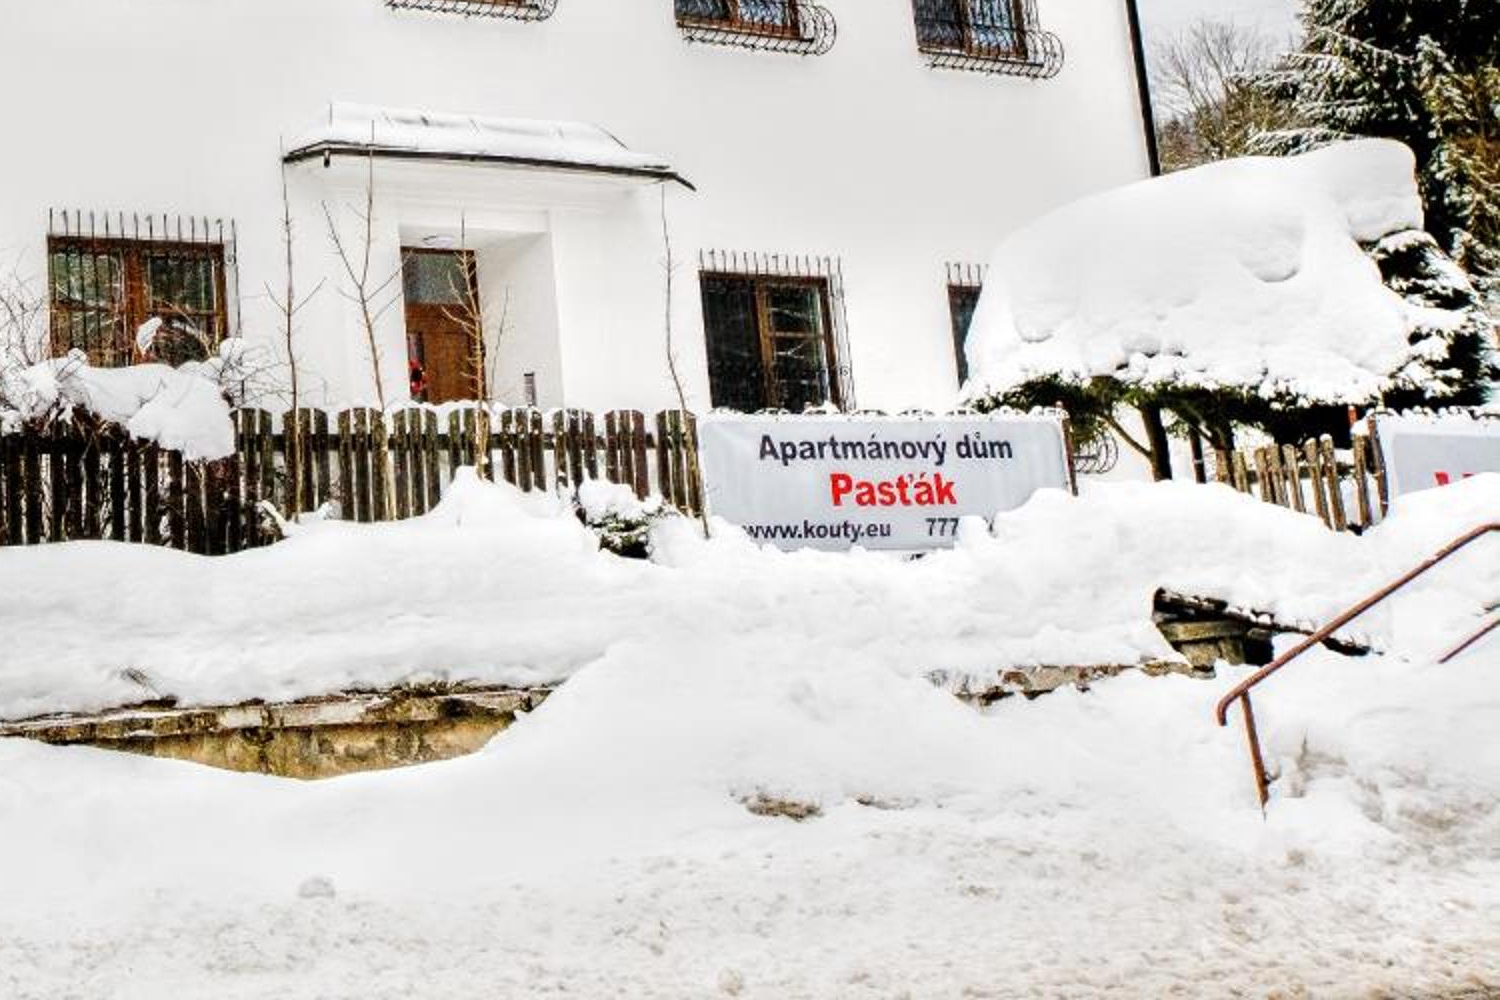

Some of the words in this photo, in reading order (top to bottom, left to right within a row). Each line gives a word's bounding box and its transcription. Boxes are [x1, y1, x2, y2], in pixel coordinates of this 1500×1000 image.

[758, 433, 947, 466] Apartmánový
[955, 431, 1014, 460] dům
[829, 471, 958, 507] Pasťák
[742, 519, 892, 543] www.kouty.eu
[925, 517, 960, 537] 777
